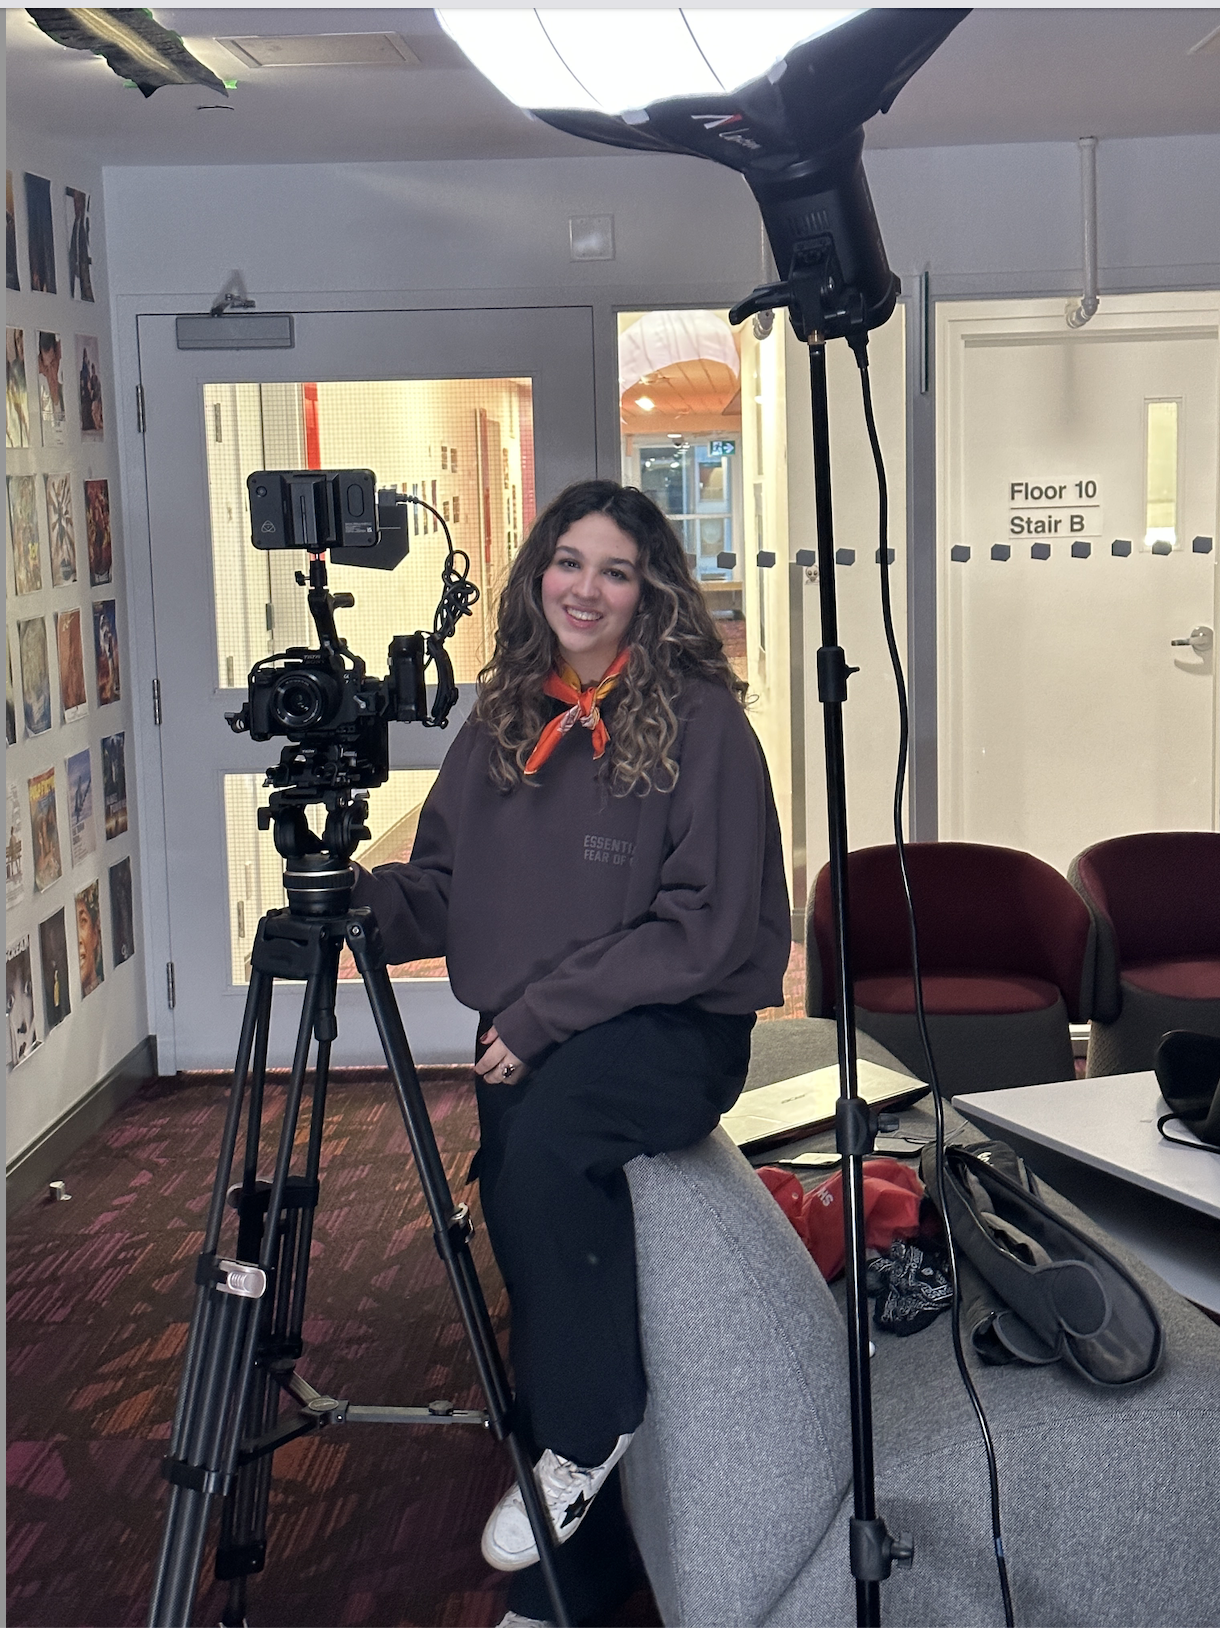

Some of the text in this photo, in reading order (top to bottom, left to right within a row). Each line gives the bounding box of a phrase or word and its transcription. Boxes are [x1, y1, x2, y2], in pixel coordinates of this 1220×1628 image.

[1010, 480, 1097, 500] Floor 10
[1010, 514, 1085, 534] Stair B
[584, 849, 609, 863] FEAR
[613, 854, 627, 866] OF
